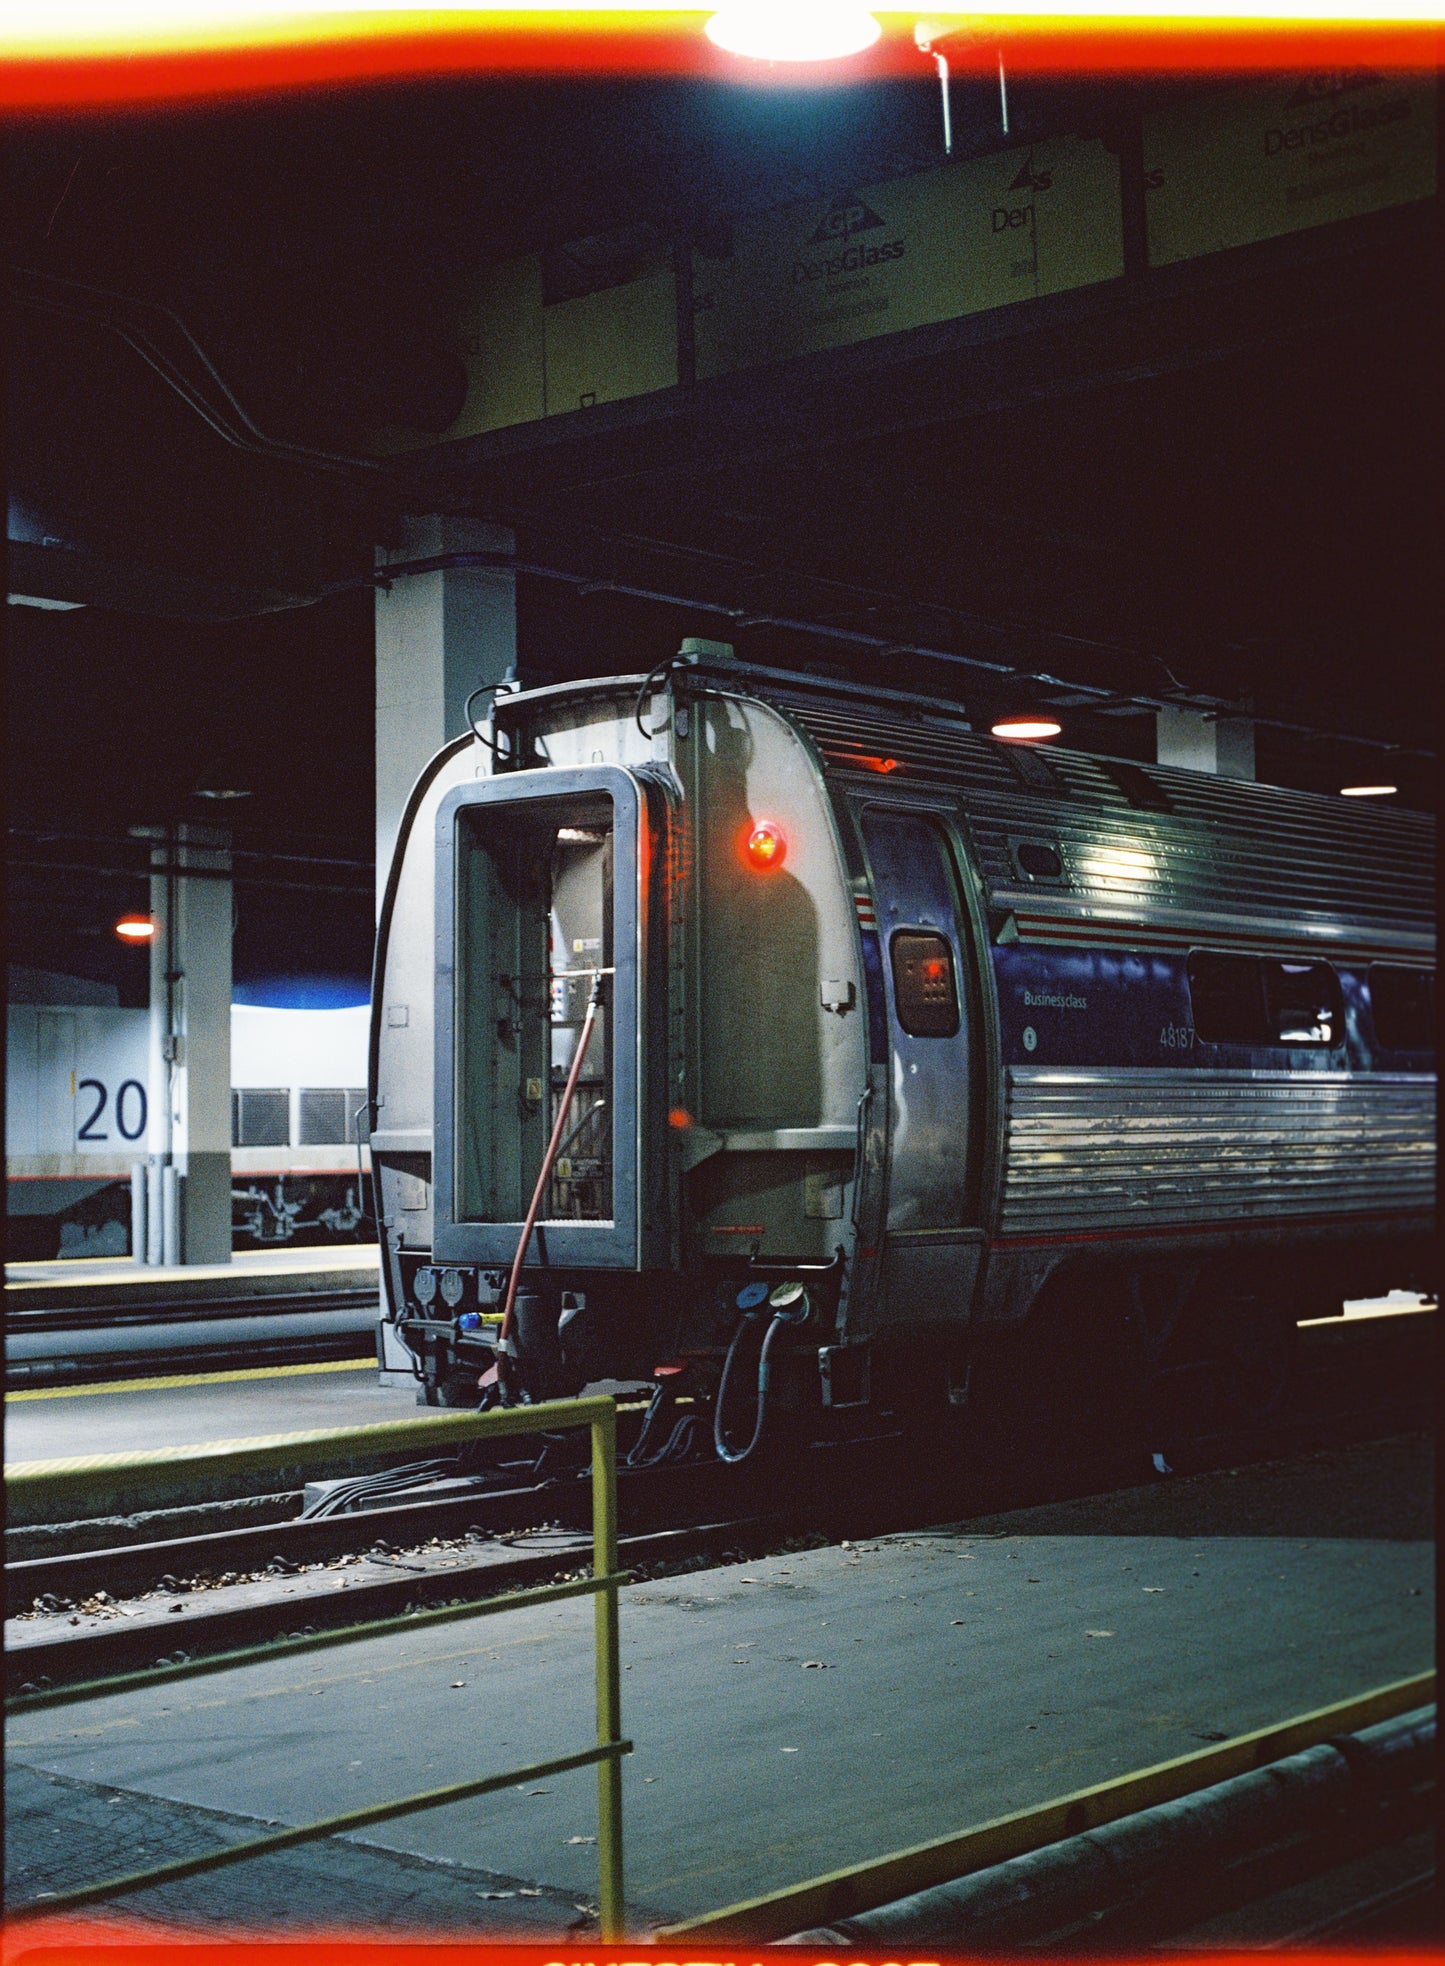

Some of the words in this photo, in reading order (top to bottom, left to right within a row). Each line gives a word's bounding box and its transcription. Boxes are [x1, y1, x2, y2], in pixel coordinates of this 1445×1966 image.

[824, 205, 866, 235] GP
[791, 239, 905, 285] DensGlass
[1159, 1026, 1196, 1049] 48187
[78, 1079, 148, 1140] 20
